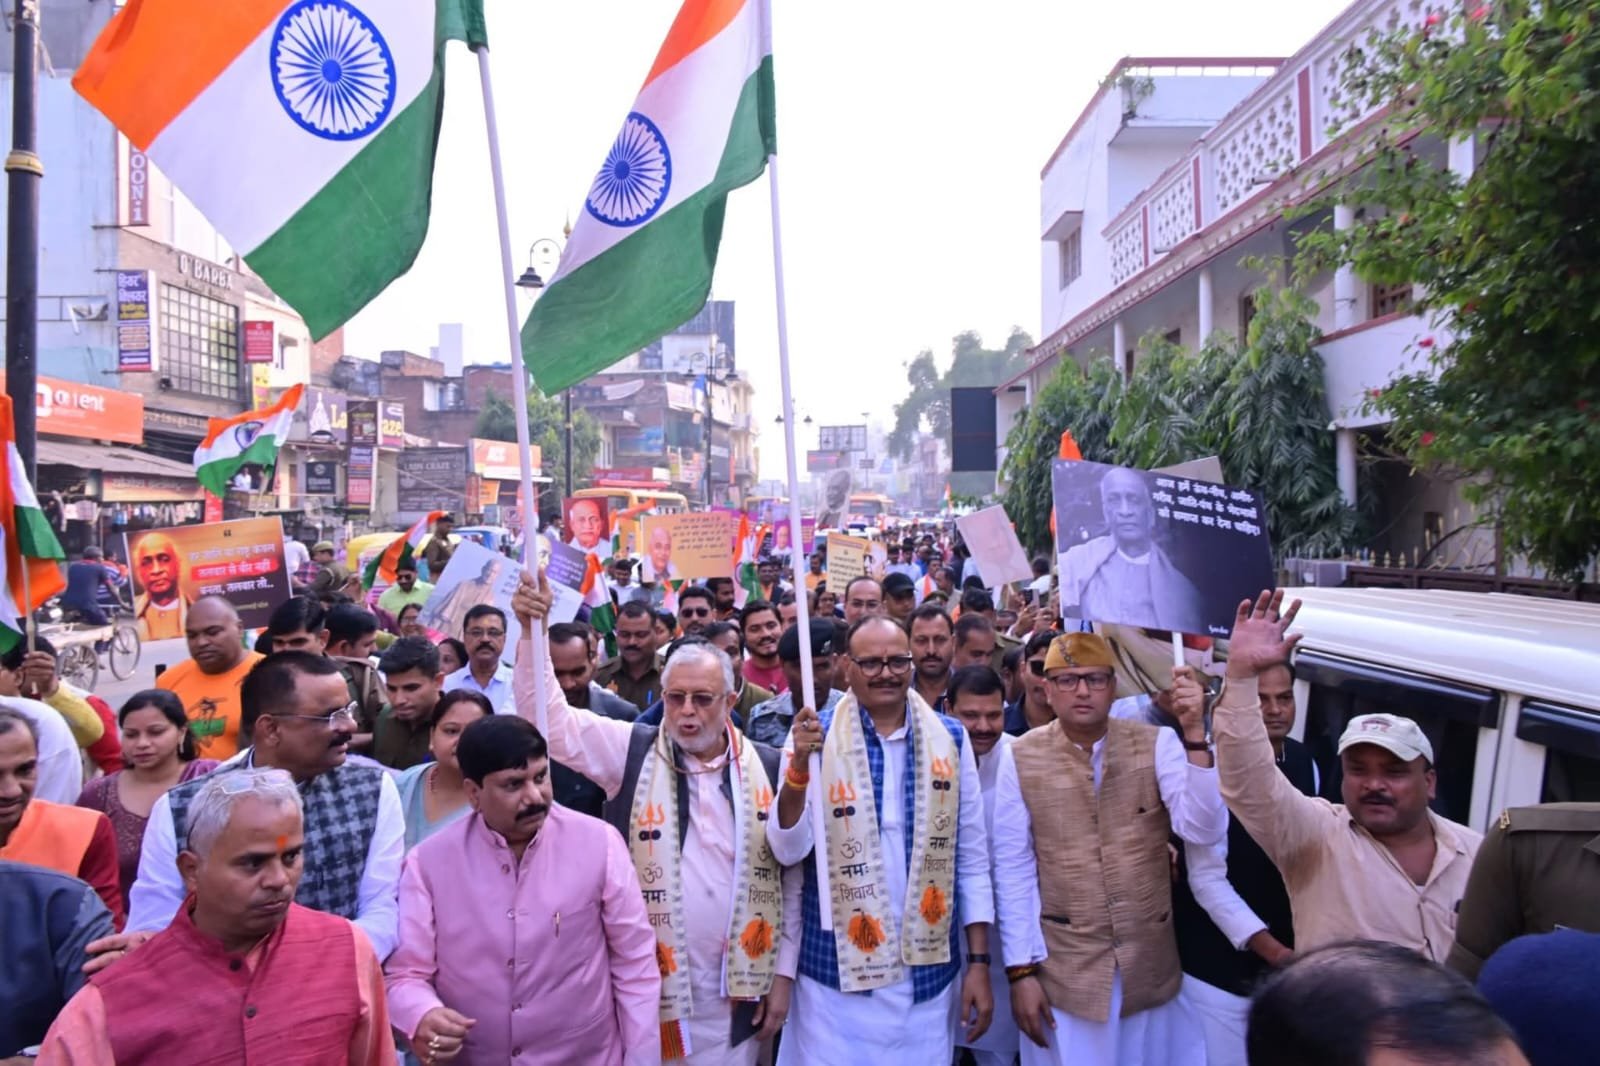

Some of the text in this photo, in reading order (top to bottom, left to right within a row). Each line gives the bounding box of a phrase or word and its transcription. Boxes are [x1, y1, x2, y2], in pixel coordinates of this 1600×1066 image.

[226, 580, 256, 593] तलवार
[929, 837, 949, 850] नमः
[754, 866, 772, 881] नमः
[840, 862, 869, 879] नमः
